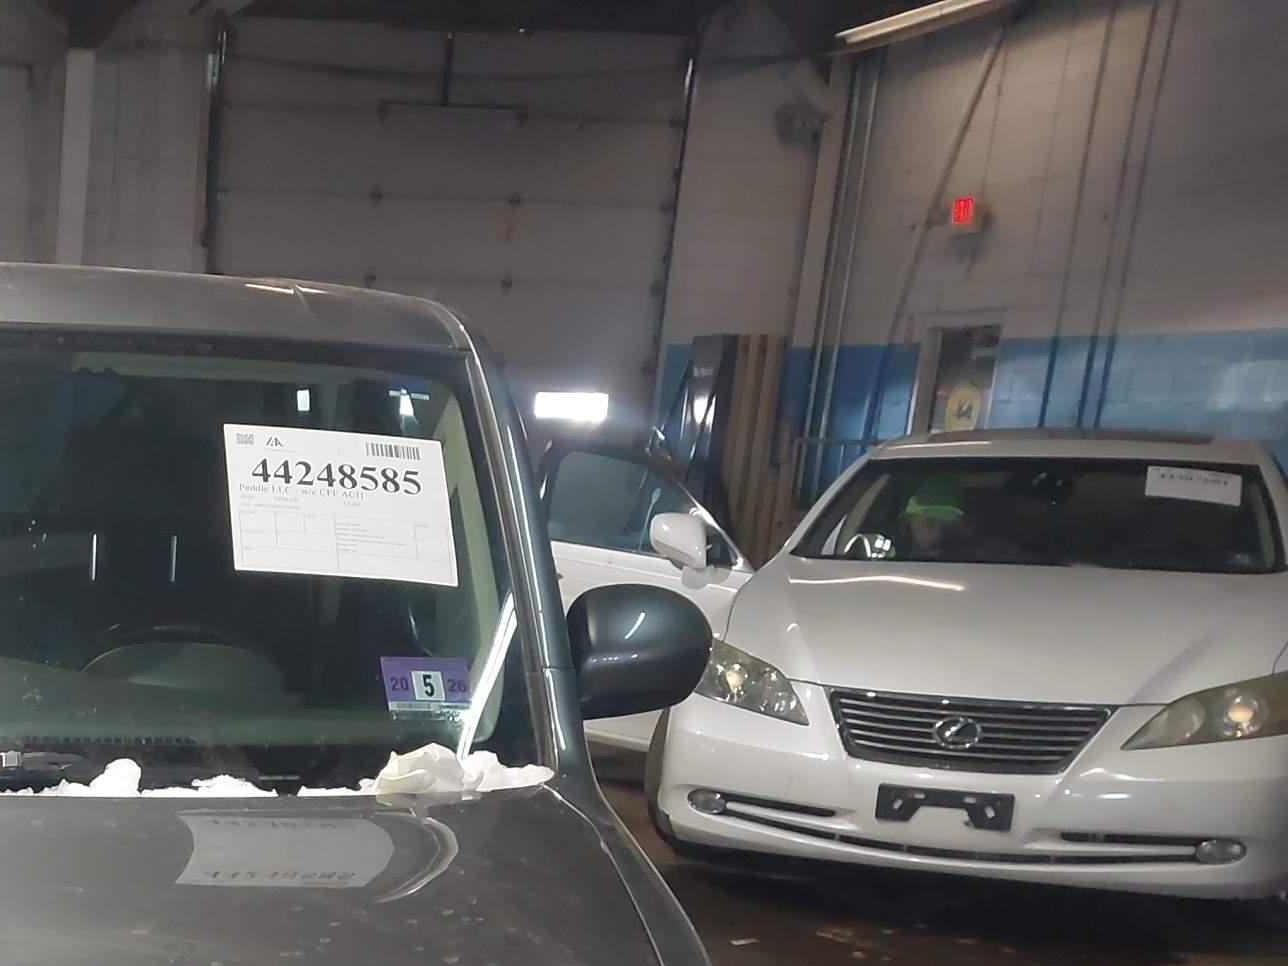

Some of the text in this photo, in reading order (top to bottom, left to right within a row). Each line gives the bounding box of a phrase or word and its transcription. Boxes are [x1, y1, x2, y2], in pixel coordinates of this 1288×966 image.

[251, 457, 422, 496] 44248585
[390, 674, 467, 697] 20 5 26
